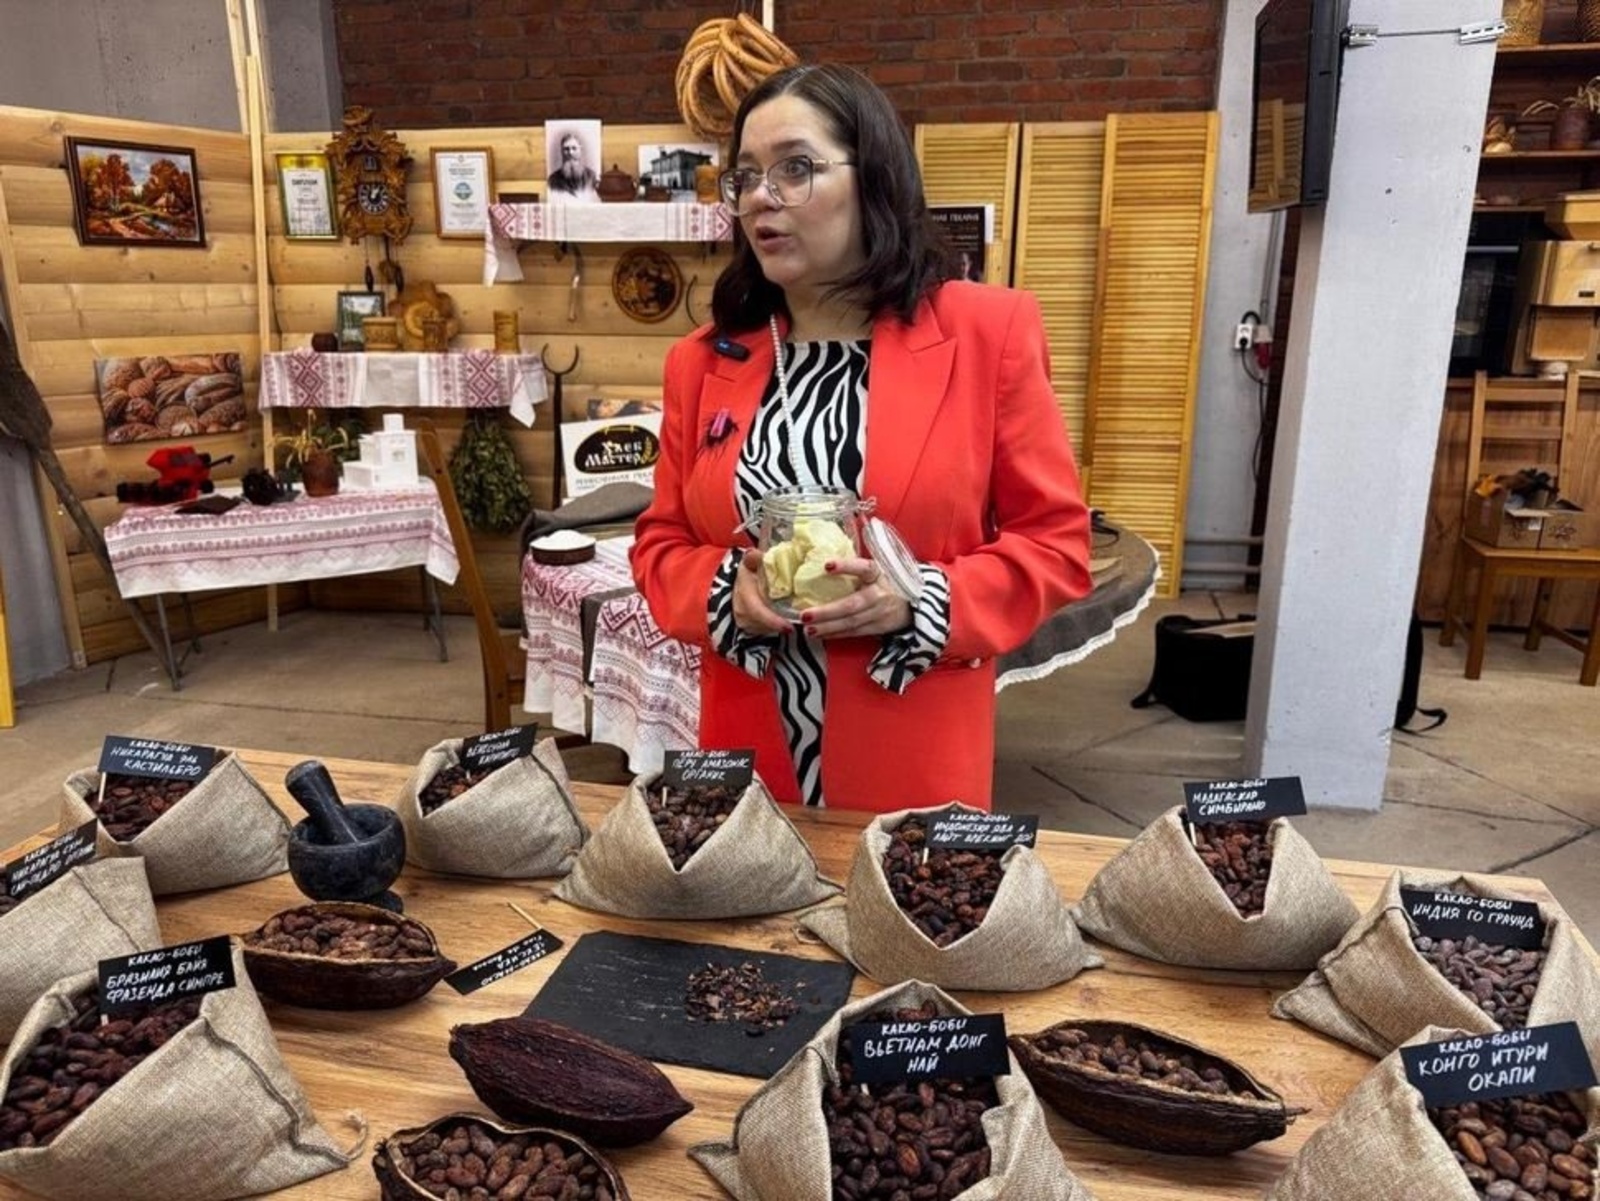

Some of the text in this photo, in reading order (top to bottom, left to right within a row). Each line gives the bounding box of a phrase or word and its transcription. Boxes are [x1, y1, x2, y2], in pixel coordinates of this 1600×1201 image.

[110, 746, 174, 762] НИКАРАГУА
[1192, 790, 1258, 804] МАДАГАСКАР
[1434, 892, 1513, 910] КАКАО-БОБЫ
[1412, 903, 1535, 930] ИНДИЯ ГО ГРАУНД
[128, 944, 204, 967] КАКАО-БОБЫ
[106, 964, 173, 989] БРАЗИЛИЯ
[106, 981, 176, 1004] ФАЗЕНДА
[882, 1018, 968, 1036] КАКАО-БОБЫ
[863, 1033, 988, 1058] ВЬЕТНАМ ДОНГ
[1438, 1029, 1532, 1054] КАКАО-БОБЫ
[906, 1053, 940, 1074] НАЙ
[1418, 1041, 1549, 1077] КОНГО ИТУРИ
[1467, 1065, 1537, 1092] ОКАПИ
